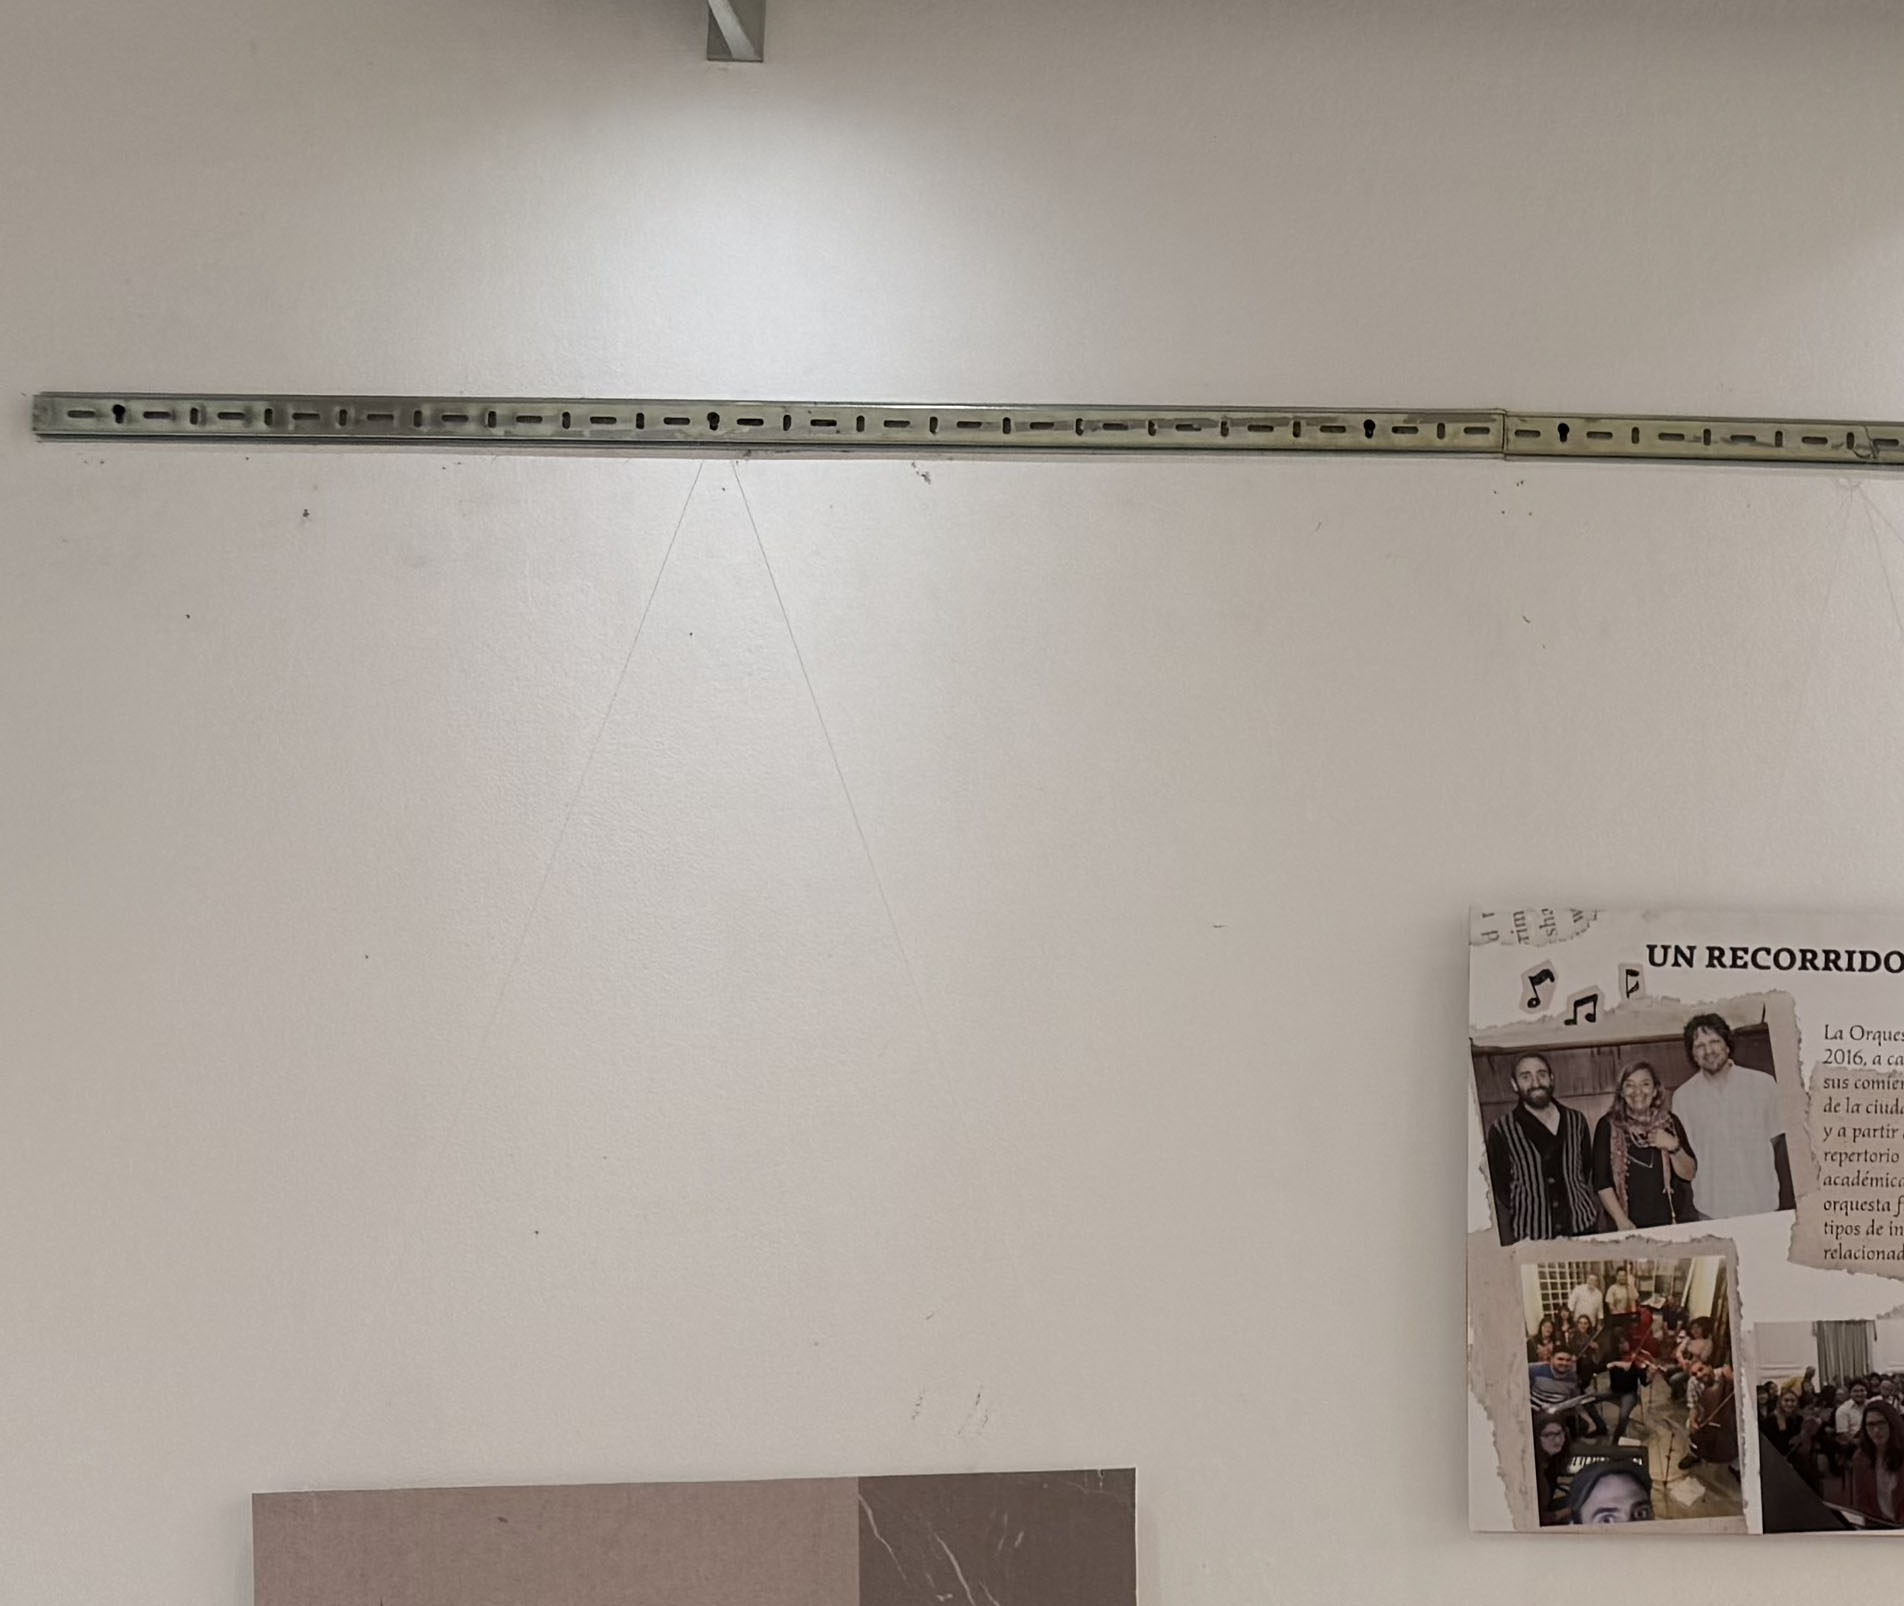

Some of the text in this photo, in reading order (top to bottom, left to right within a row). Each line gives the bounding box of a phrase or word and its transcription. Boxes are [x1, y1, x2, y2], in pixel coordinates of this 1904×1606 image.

[1645, 944, 1697, 969] UN
[1824, 1023, 1844, 1041] La
[1823, 1050, 1867, 1069] 2016,
[1872, 1054, 1883, 1067] a
